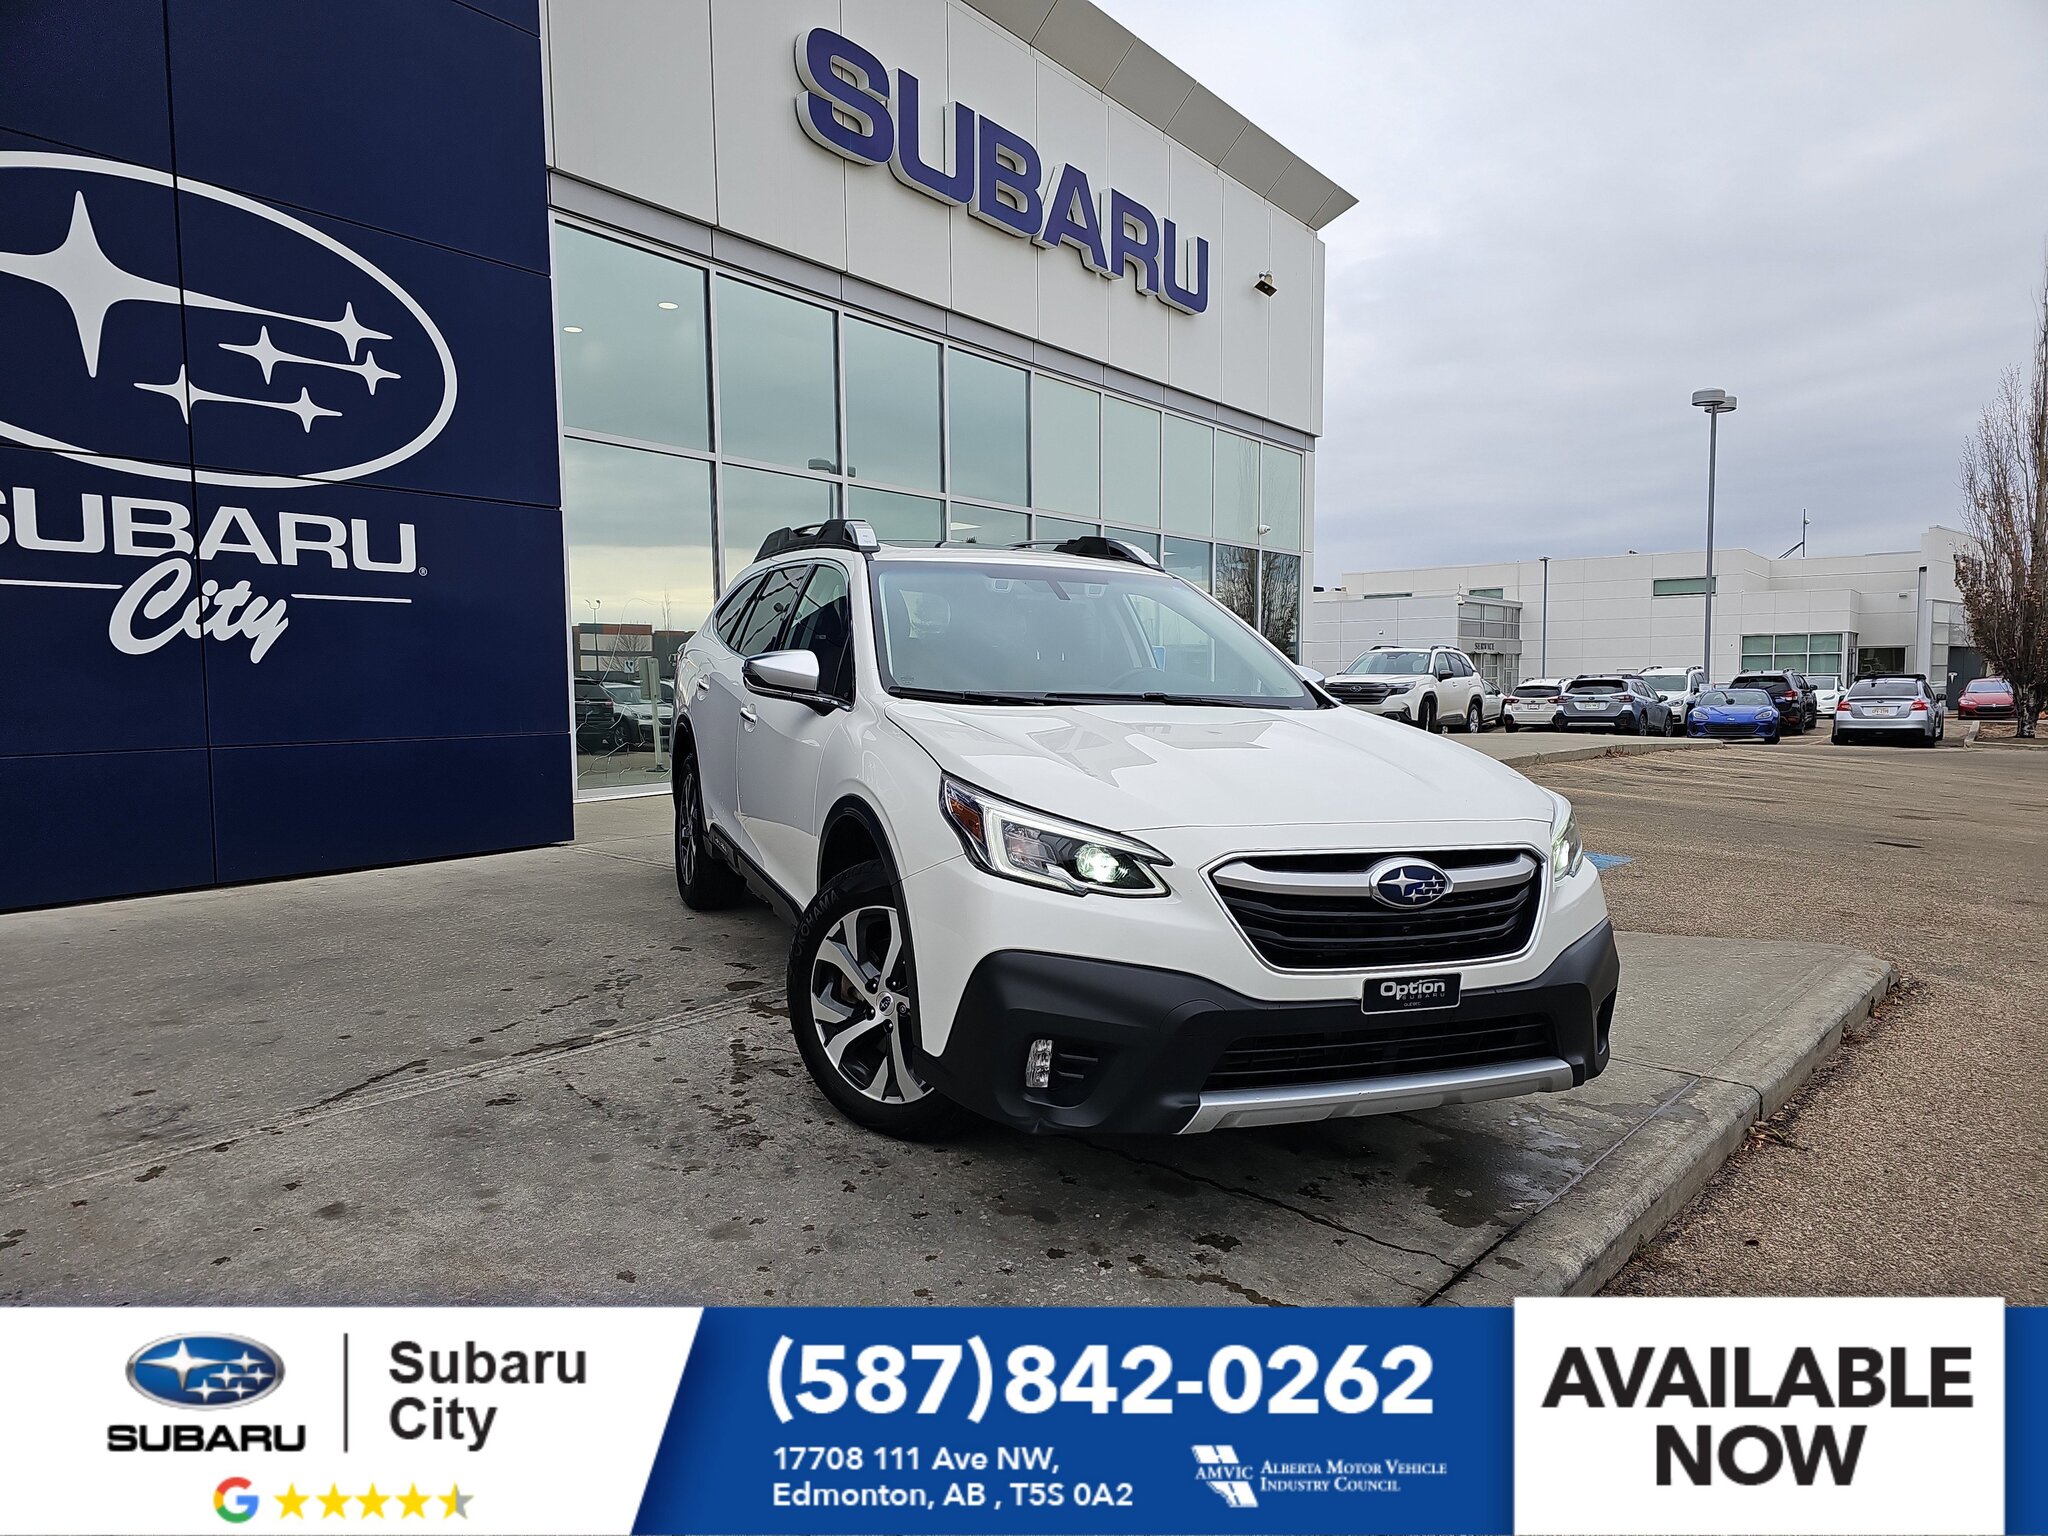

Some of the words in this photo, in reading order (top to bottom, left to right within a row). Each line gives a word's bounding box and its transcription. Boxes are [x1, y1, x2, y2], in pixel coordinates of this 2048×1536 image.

[796, 27, 1209, 315] SUBARU
[0, 486, 416, 574] UBARU
[109, 558, 289, 663] City
[1381, 979, 1446, 1001] Option
